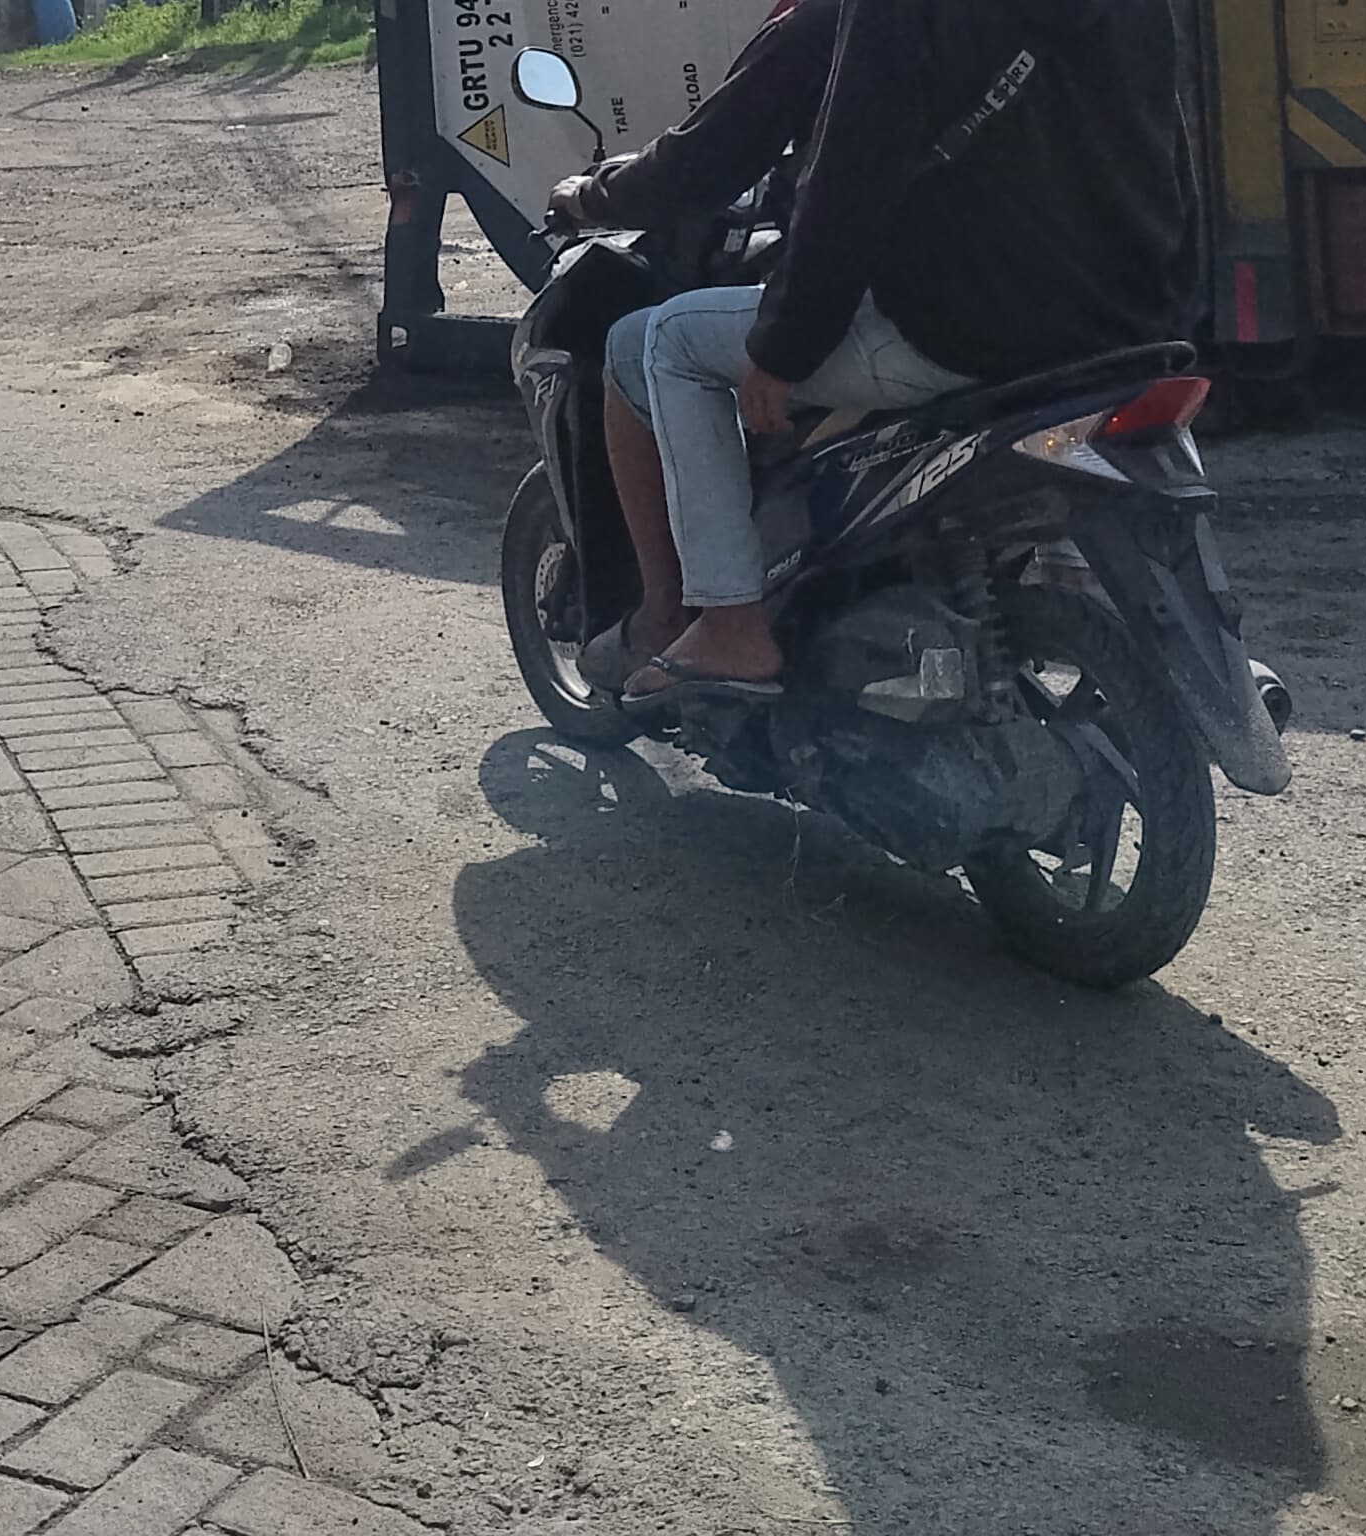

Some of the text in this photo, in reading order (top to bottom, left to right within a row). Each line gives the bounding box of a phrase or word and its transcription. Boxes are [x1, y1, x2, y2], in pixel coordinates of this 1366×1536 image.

[458, 39, 490, 112] GRTU
[683, 63, 700, 113] YLOAD
[611, 96, 628, 135] TARE
[897, 432, 981, 506] 125
